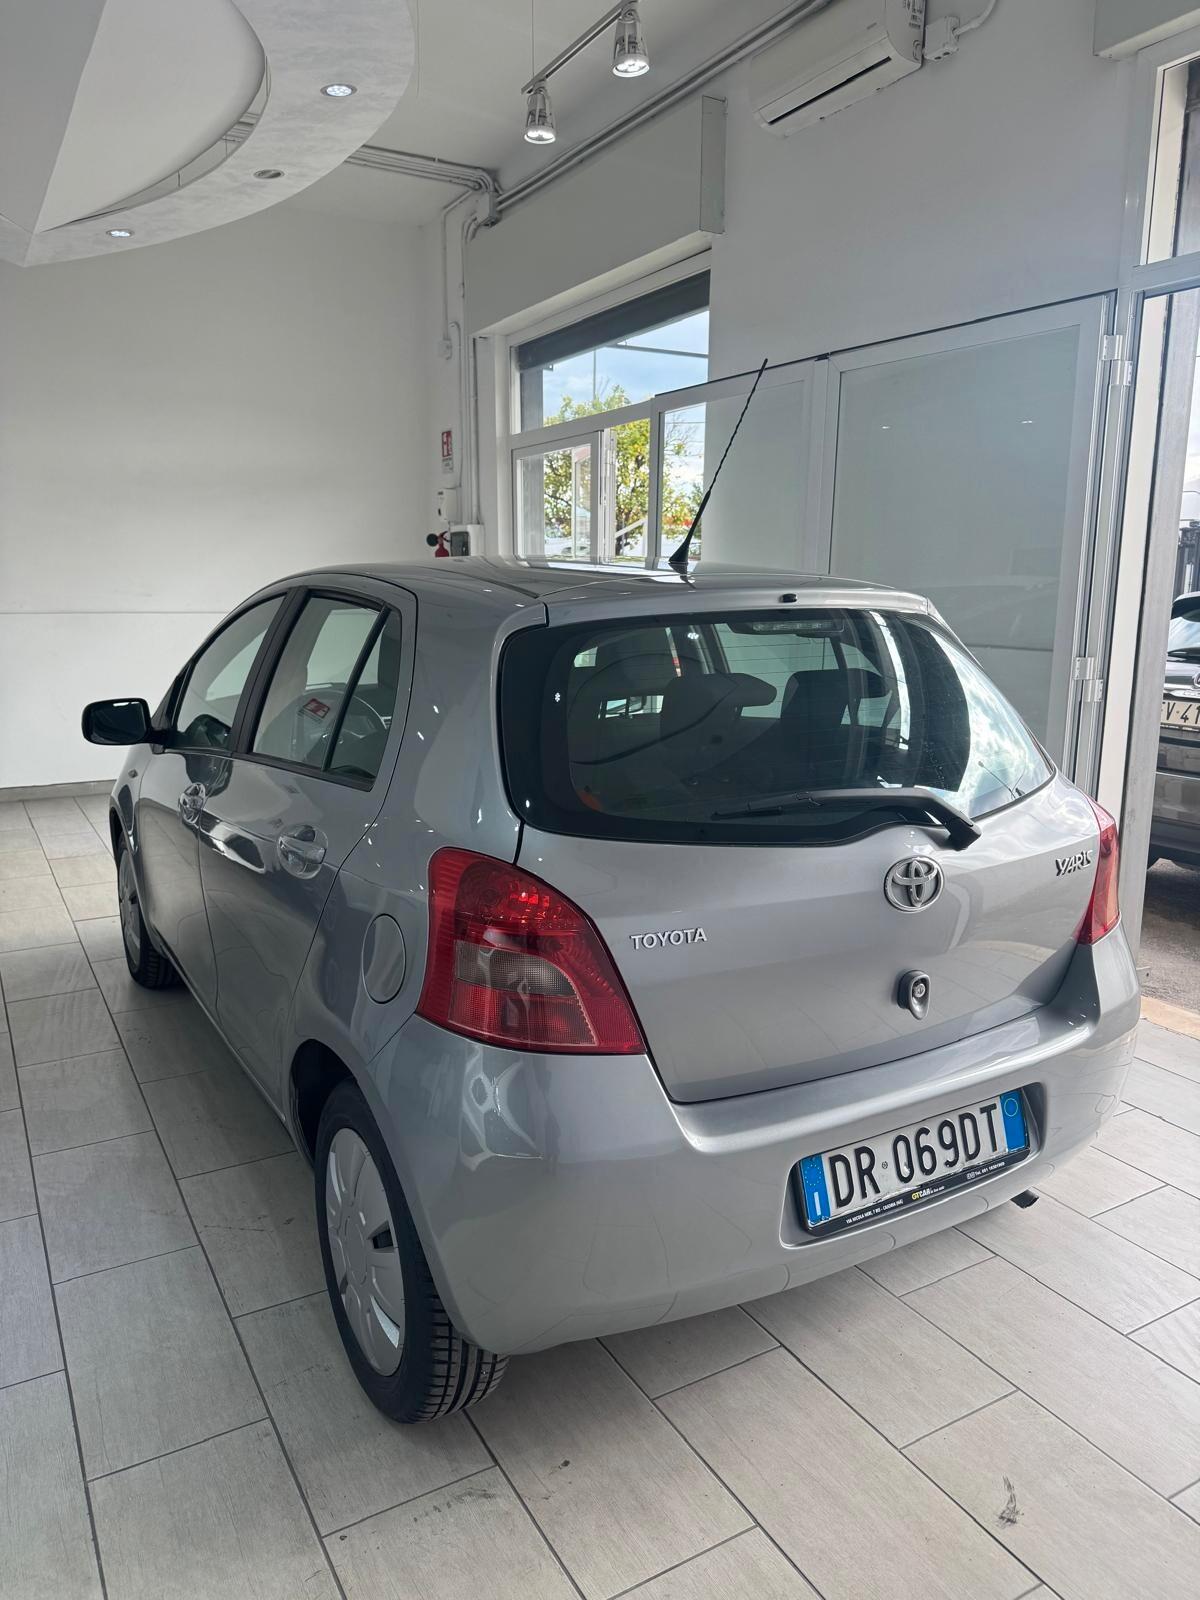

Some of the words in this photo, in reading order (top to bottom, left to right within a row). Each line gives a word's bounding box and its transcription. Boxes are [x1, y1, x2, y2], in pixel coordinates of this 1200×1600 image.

[1055, 850, 1094, 877] YARIS
[629, 927, 708, 950] TOYOTA
[828, 1146, 881, 1209] DR
[893, 1103, 998, 1184] 069DT
